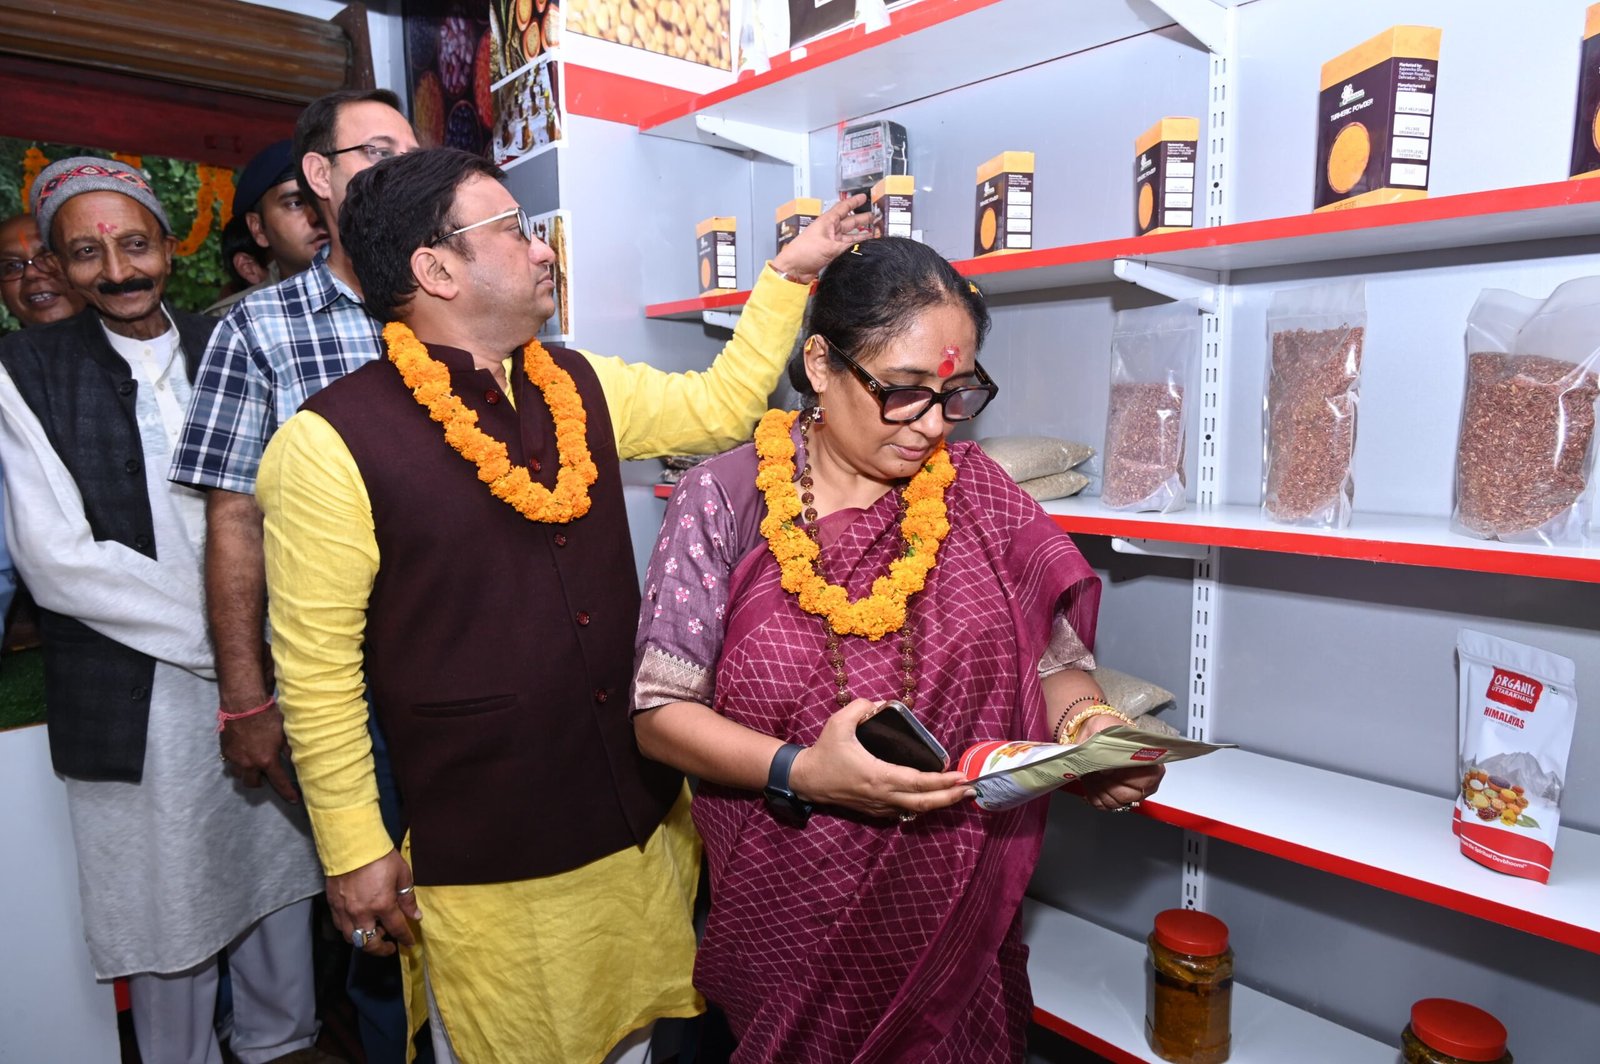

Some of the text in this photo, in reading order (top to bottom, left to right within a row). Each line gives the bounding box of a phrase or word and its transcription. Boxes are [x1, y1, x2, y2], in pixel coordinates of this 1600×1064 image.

[1352, 98, 1374, 113] POWDER
[1491, 685, 1534, 704] UTTARAKHAND
[1494, 674, 1536, 697] ORGANIC
[1483, 706, 1525, 729] HIMALAYAS
[1474, 846, 1493, 859] Spiritual
